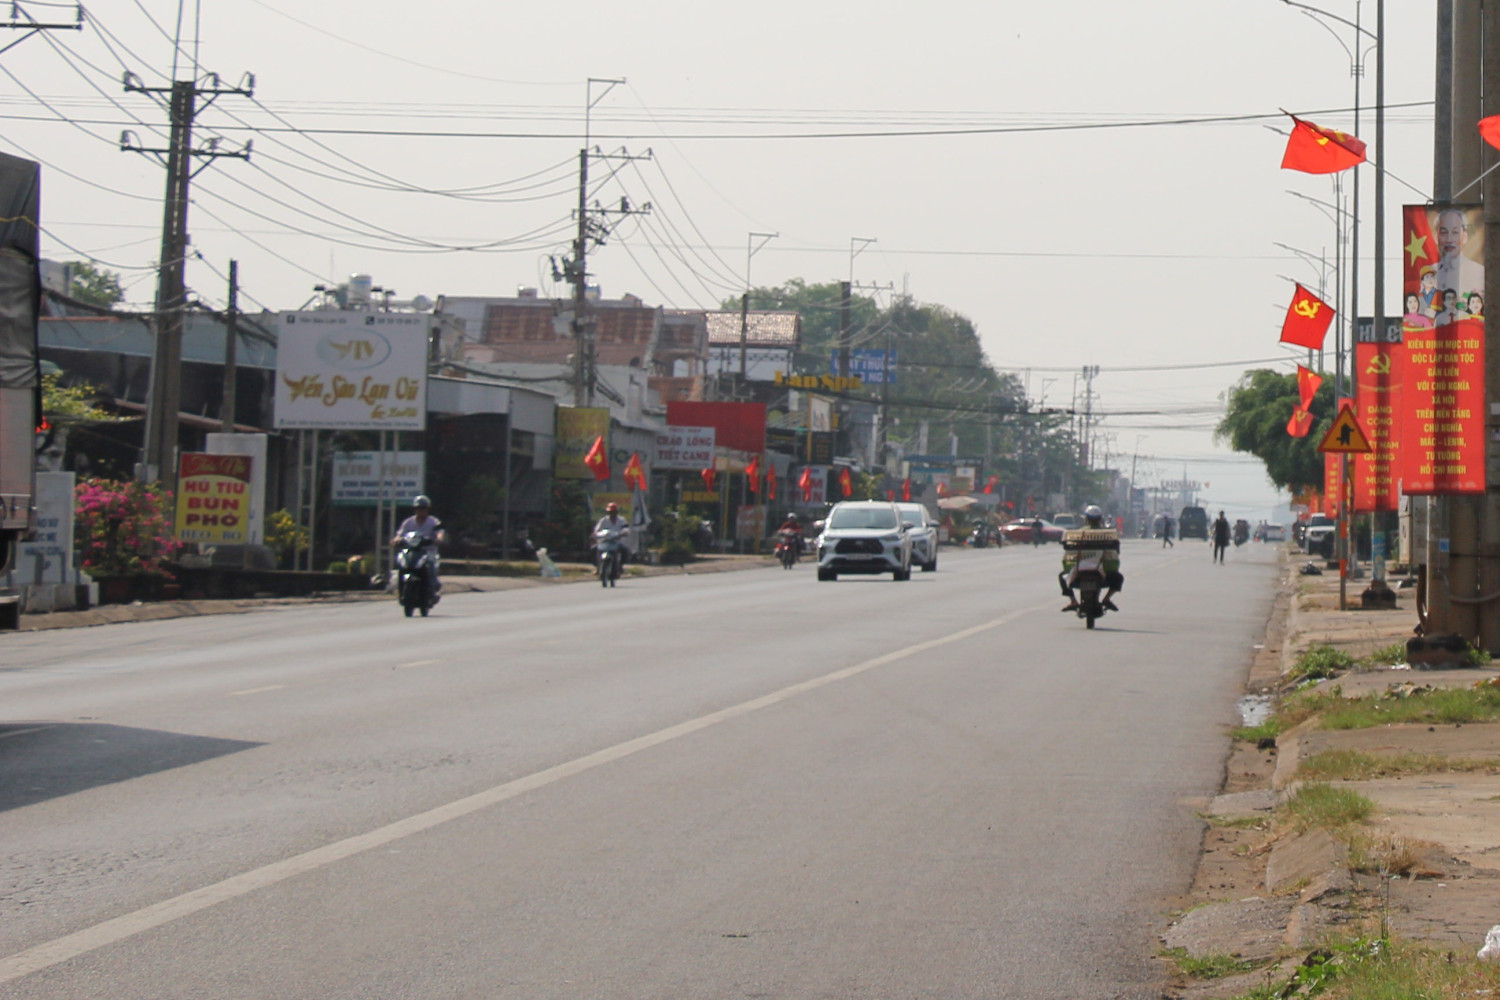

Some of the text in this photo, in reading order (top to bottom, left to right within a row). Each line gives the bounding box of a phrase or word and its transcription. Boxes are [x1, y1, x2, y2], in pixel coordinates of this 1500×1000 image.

[1447, 465, 1466, 474] MINH
[188, 495, 240, 510] BÚN
[185, 511, 241, 526] PHỞ
